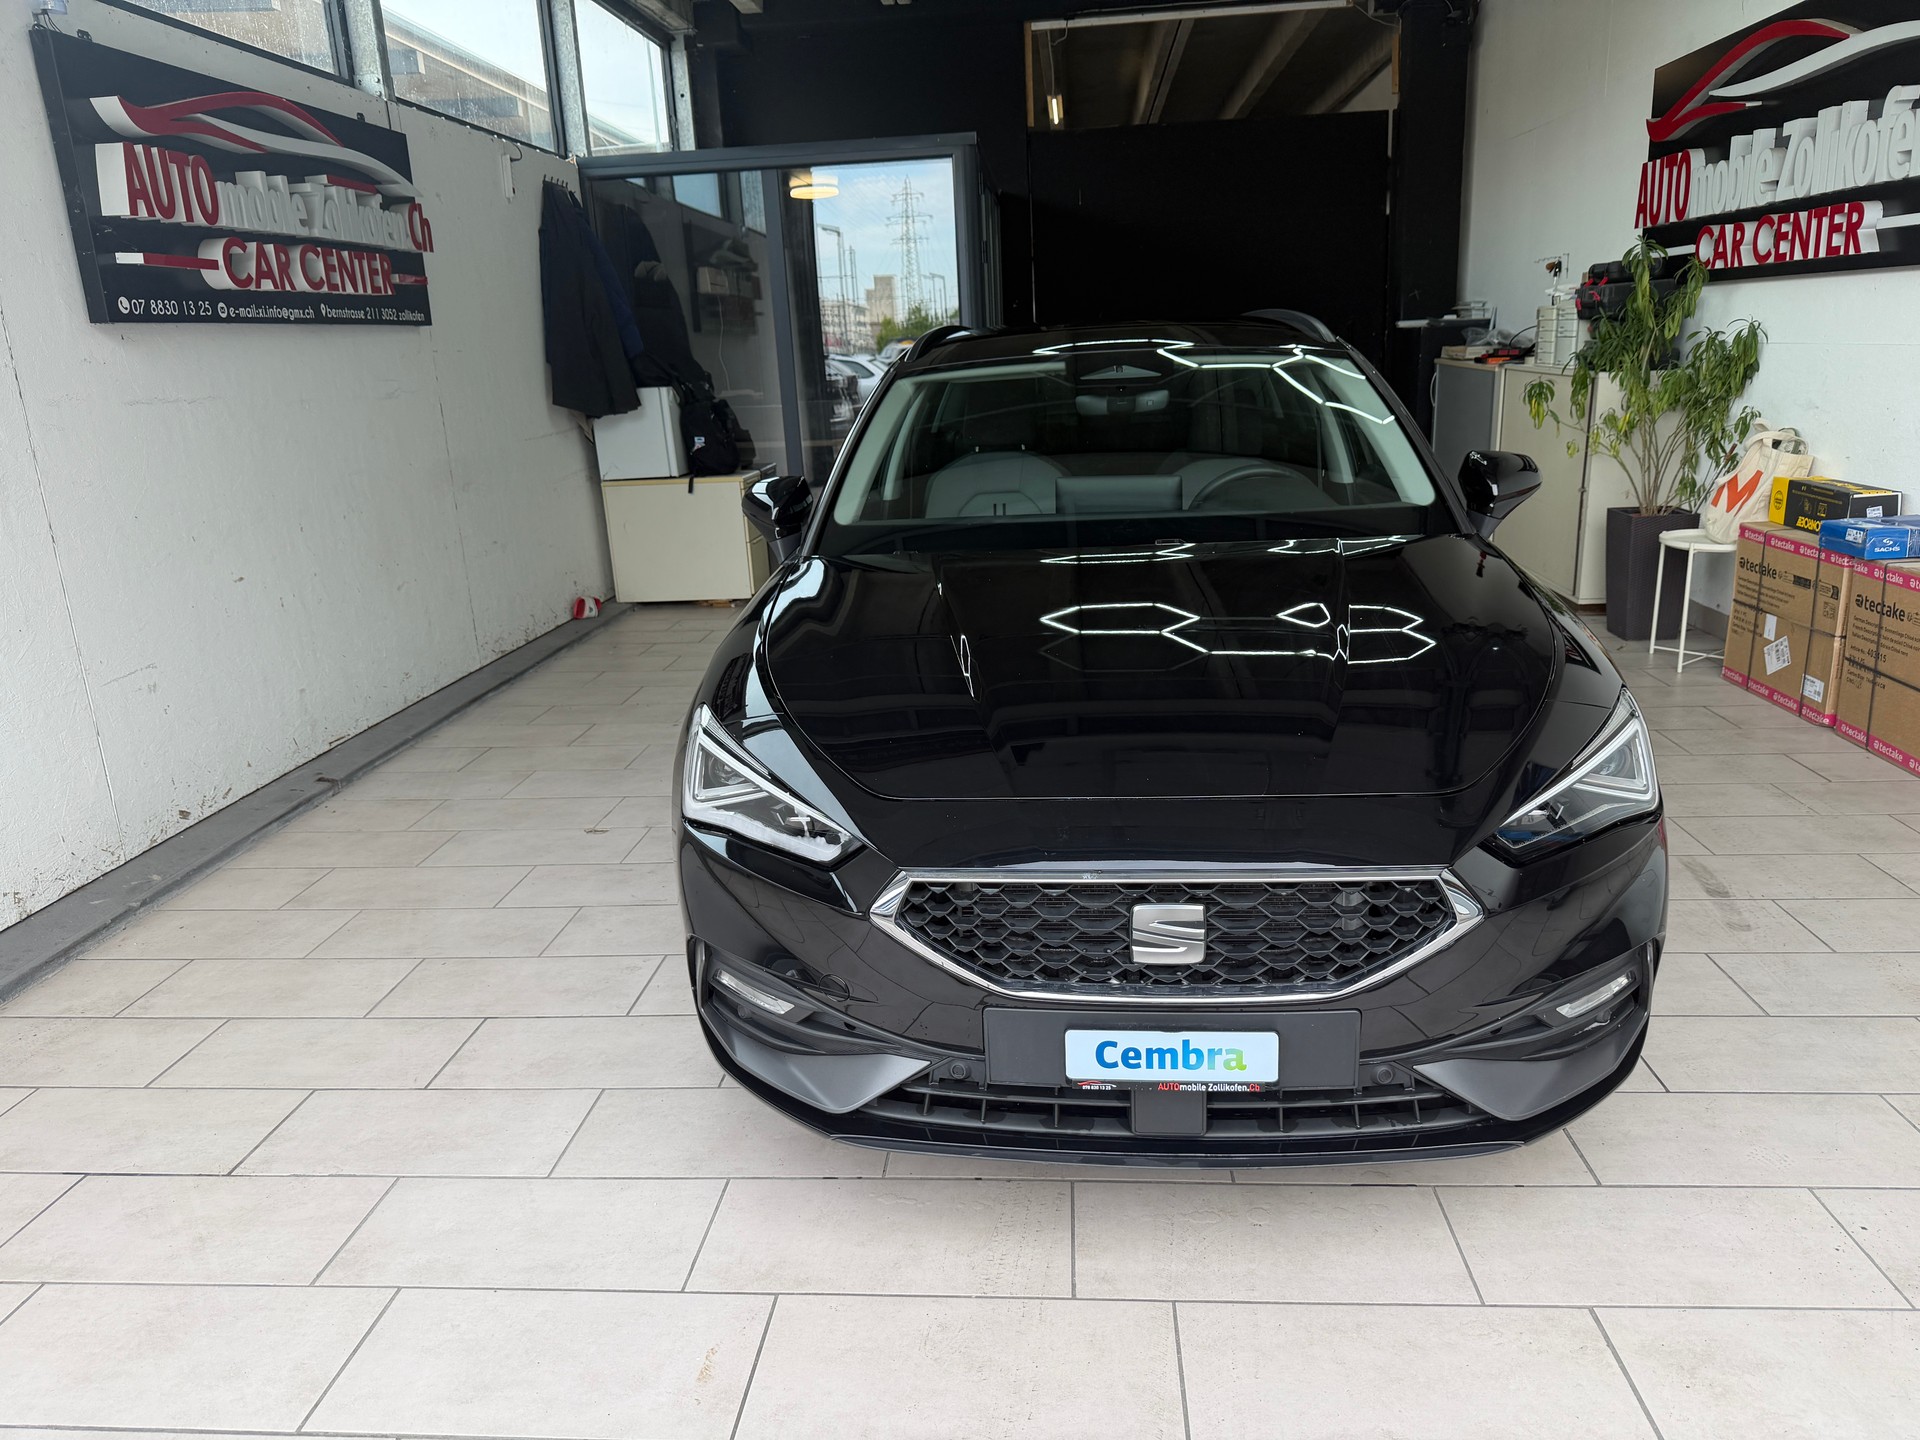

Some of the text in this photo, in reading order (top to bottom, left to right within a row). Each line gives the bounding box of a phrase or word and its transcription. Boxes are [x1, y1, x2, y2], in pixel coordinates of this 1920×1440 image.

[1695, 201, 1862, 269] CAR CENTER
[222, 236, 396, 295] CAR CENTER
[131, 299, 213, 316] 07 8830 13 25
[366, 306, 380, 320] 211
[381, 308, 398, 321] 3052
[1795, 515, 1822, 533] ONROE
[1094, 1038, 1248, 1072] Cembra
[1157, 1082, 1206, 1092] AUTOmobile
